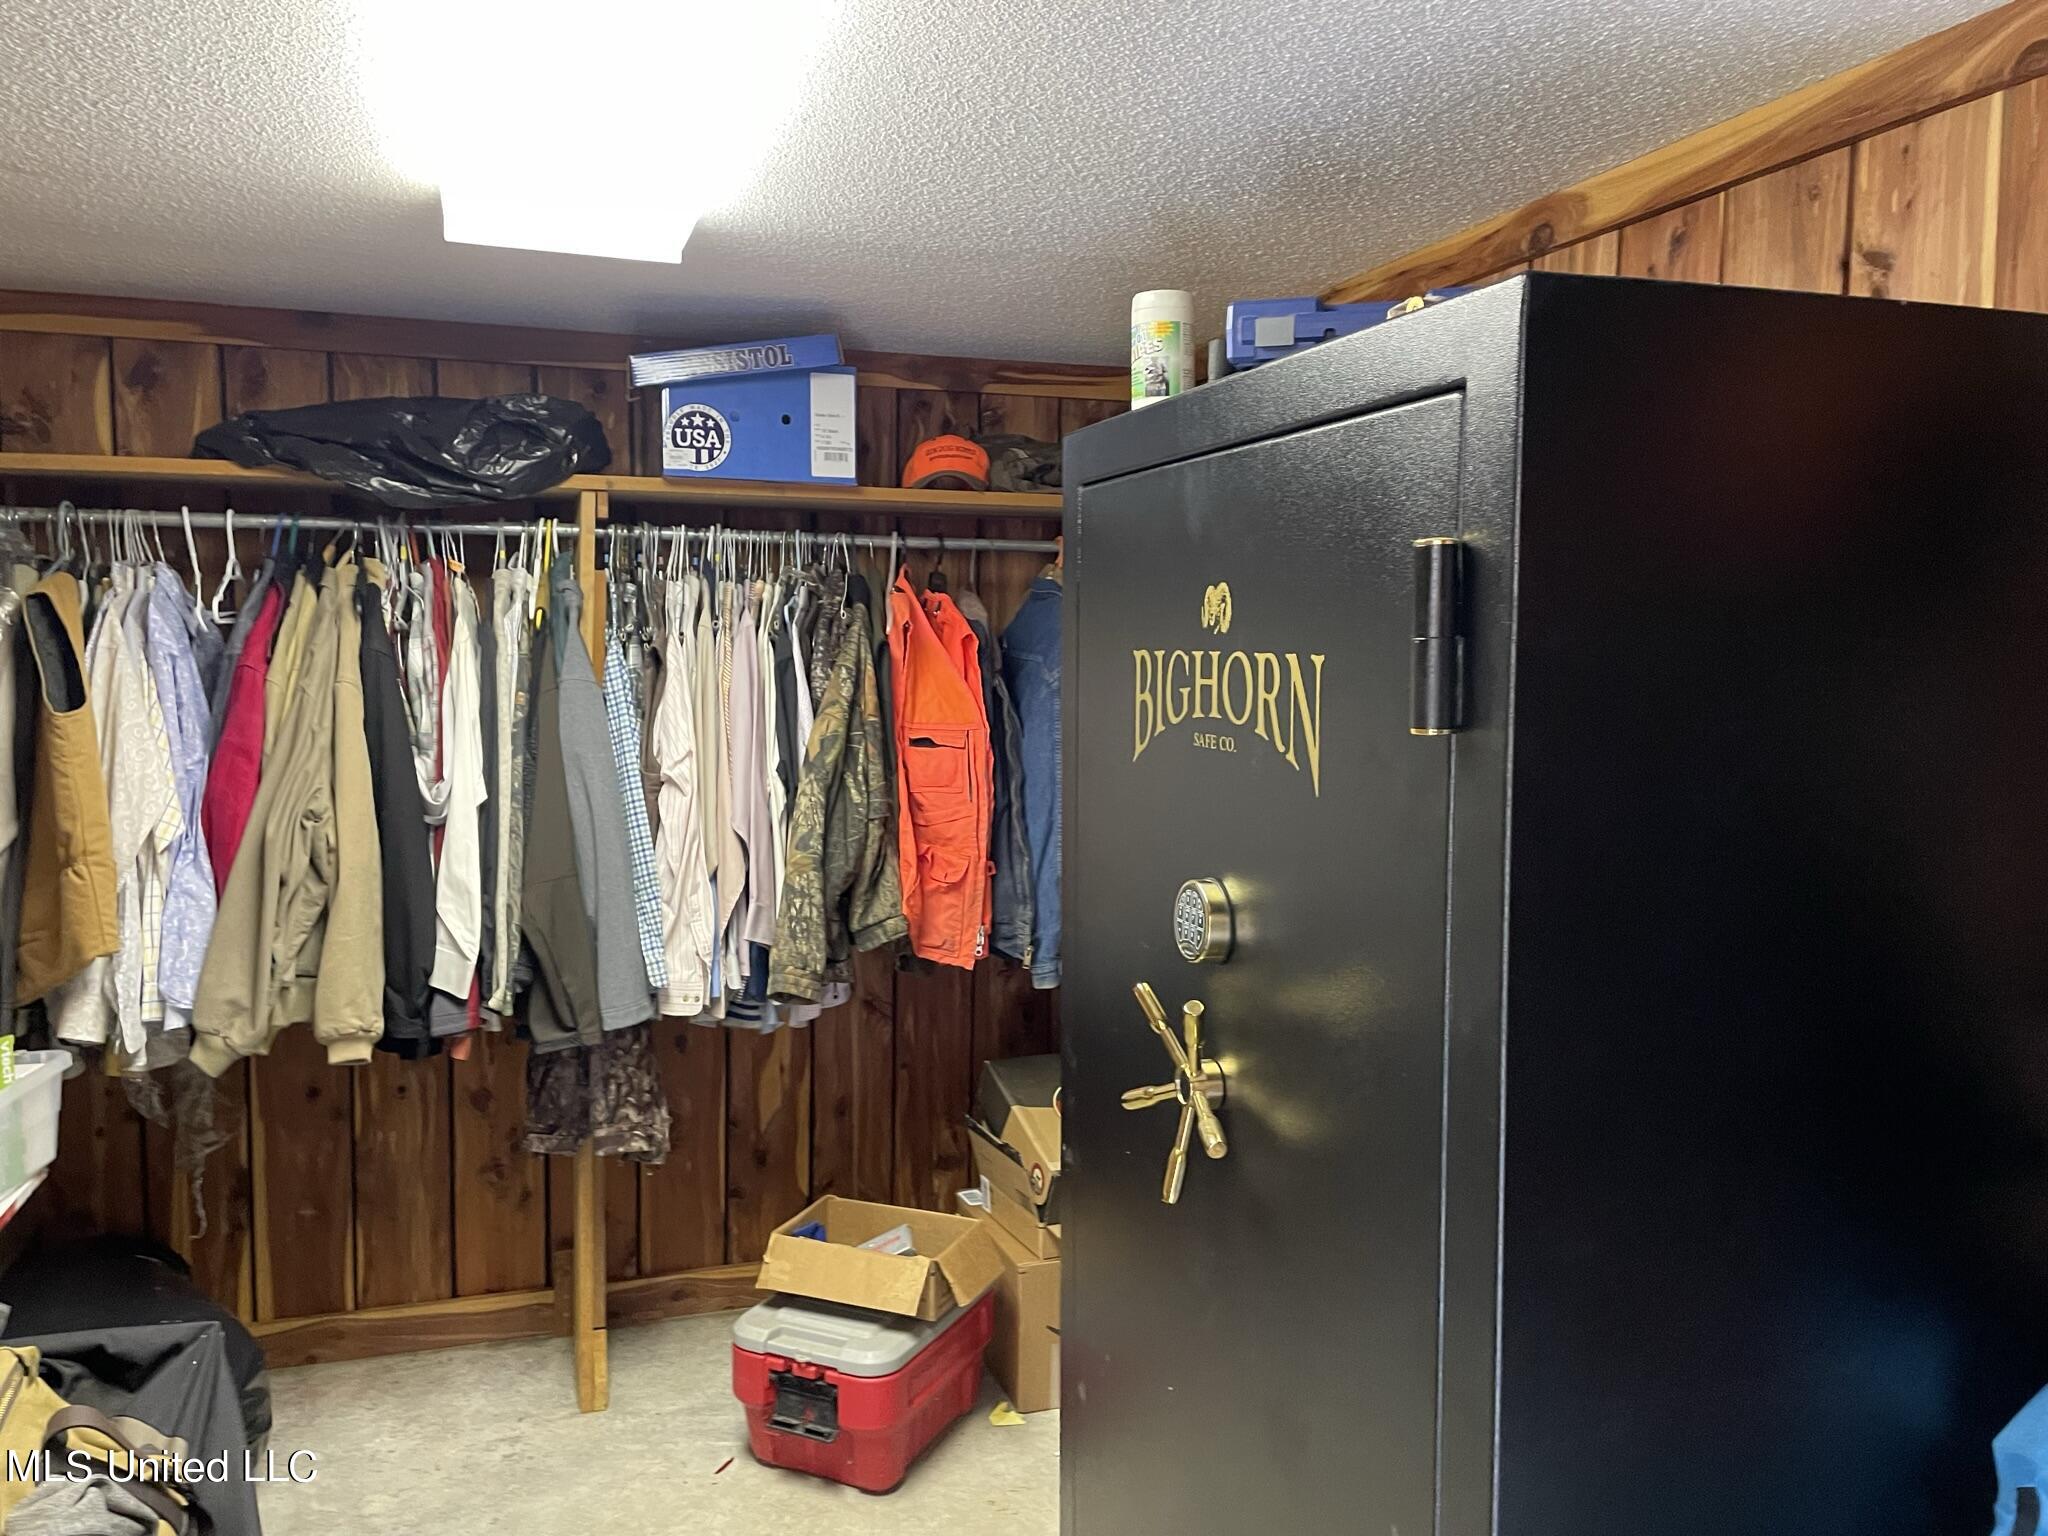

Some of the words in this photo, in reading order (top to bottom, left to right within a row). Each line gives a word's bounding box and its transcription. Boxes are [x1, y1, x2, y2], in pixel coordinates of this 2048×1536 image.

[674, 427, 722, 448] USA
[1132, 649, 1326, 798] BIGHORN
[1193, 732, 1217, 749] SAFE
[1219, 736, 1237, 752] CO.
